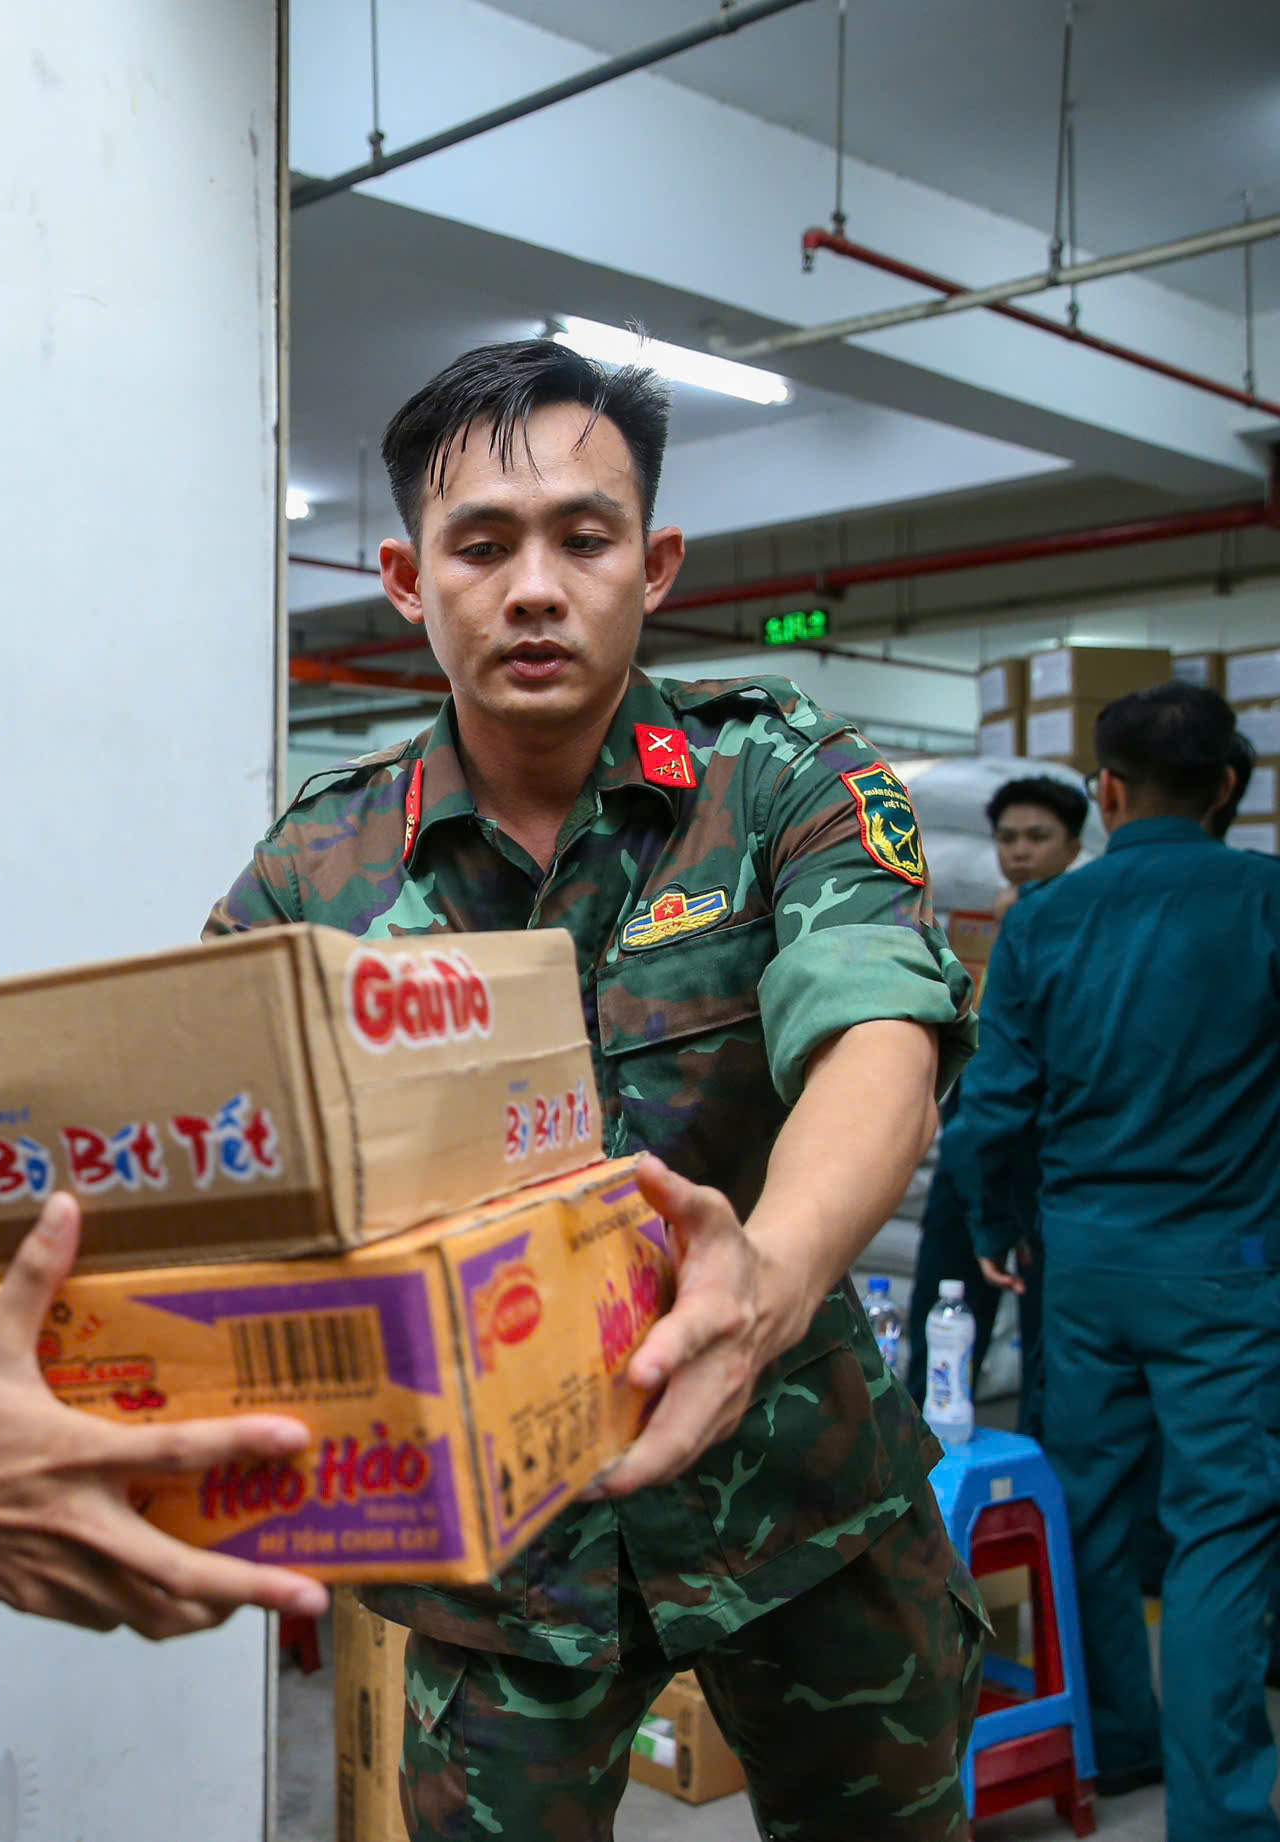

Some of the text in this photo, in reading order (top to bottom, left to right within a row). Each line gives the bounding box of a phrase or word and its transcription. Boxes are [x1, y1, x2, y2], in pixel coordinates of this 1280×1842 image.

[61, 1122, 167, 1188] Bít
[171, 1093, 277, 1180] Tết
[318, 1419, 430, 1502] Hảo
